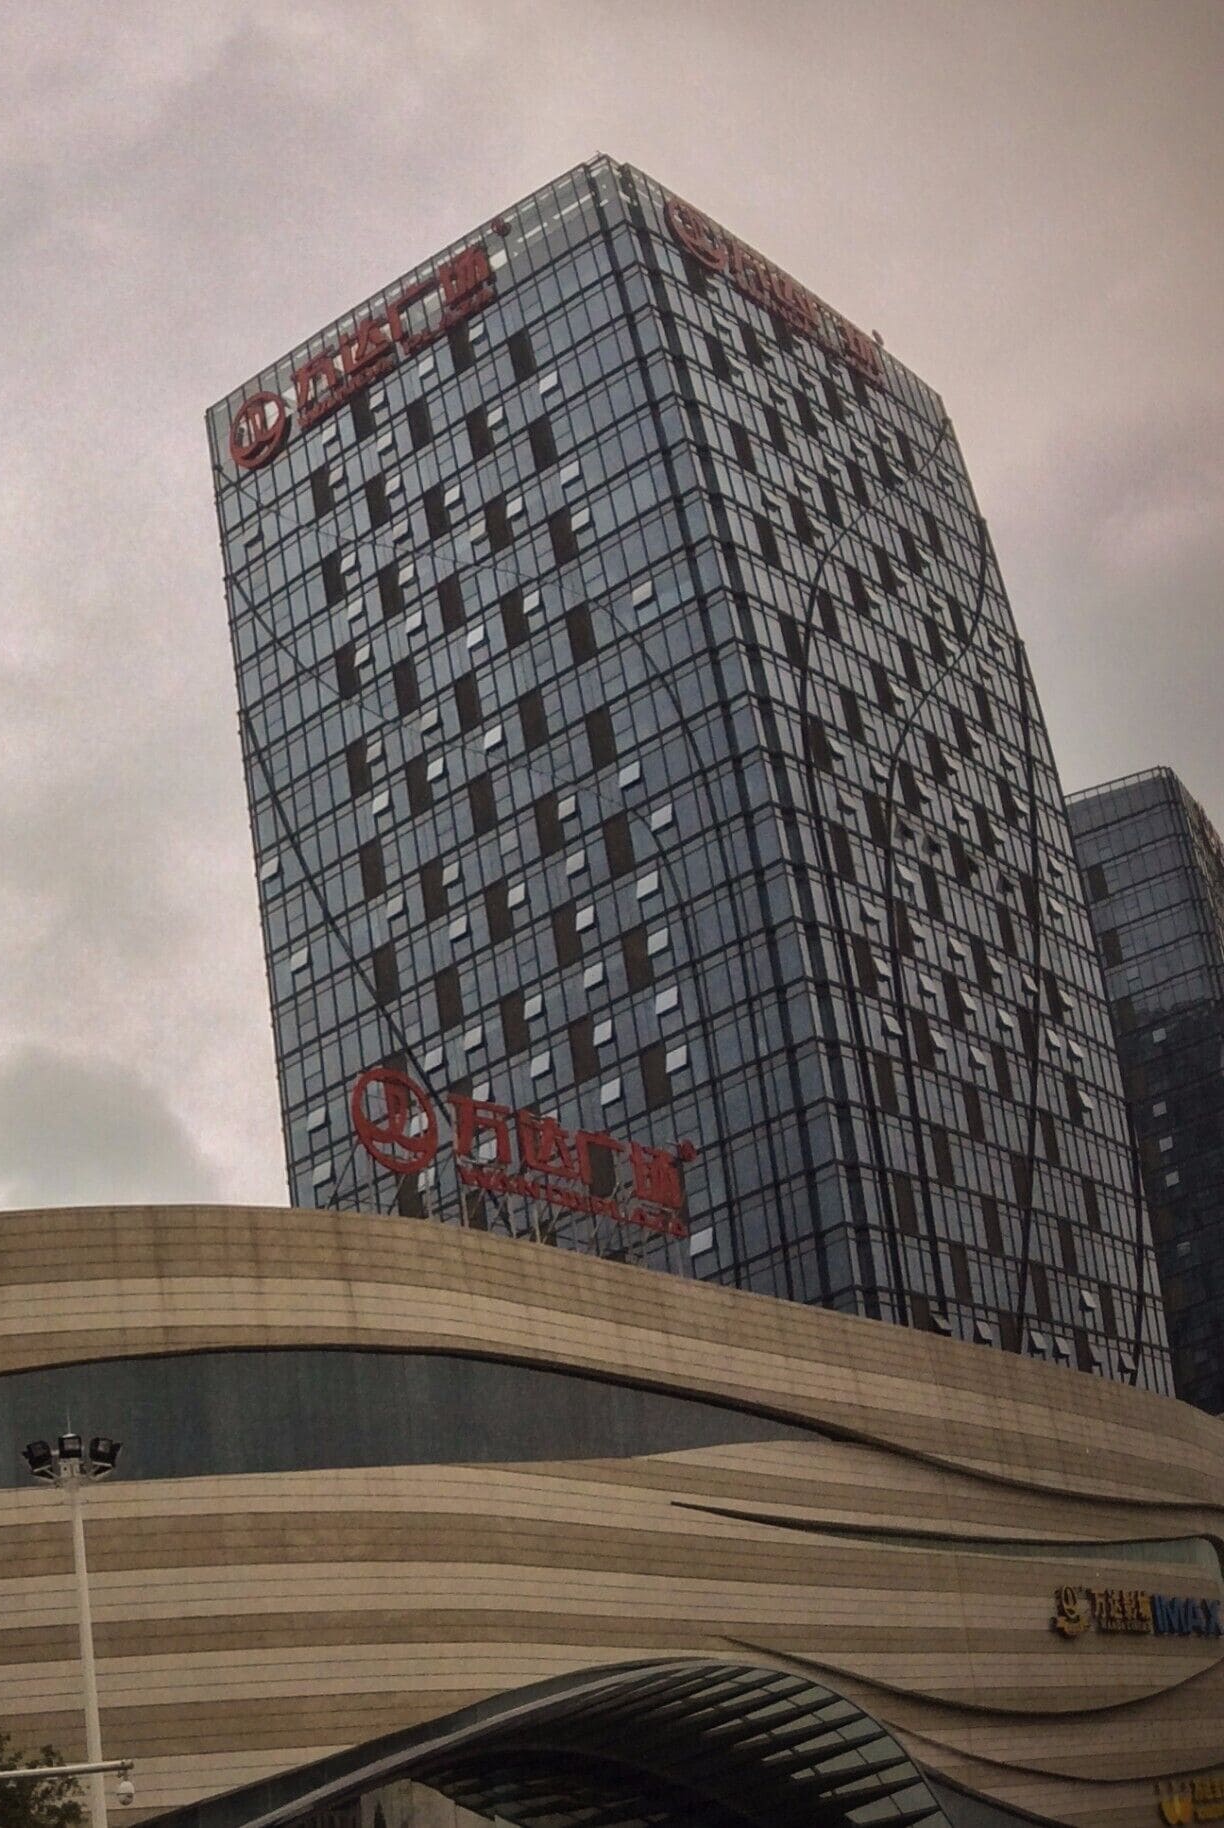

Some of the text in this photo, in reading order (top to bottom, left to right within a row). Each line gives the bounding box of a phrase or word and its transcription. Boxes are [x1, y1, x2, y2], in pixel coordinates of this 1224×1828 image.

[448, 1093, 684, 1208] 万达广场
[1152, 1594, 1223, 1635] IMAX
